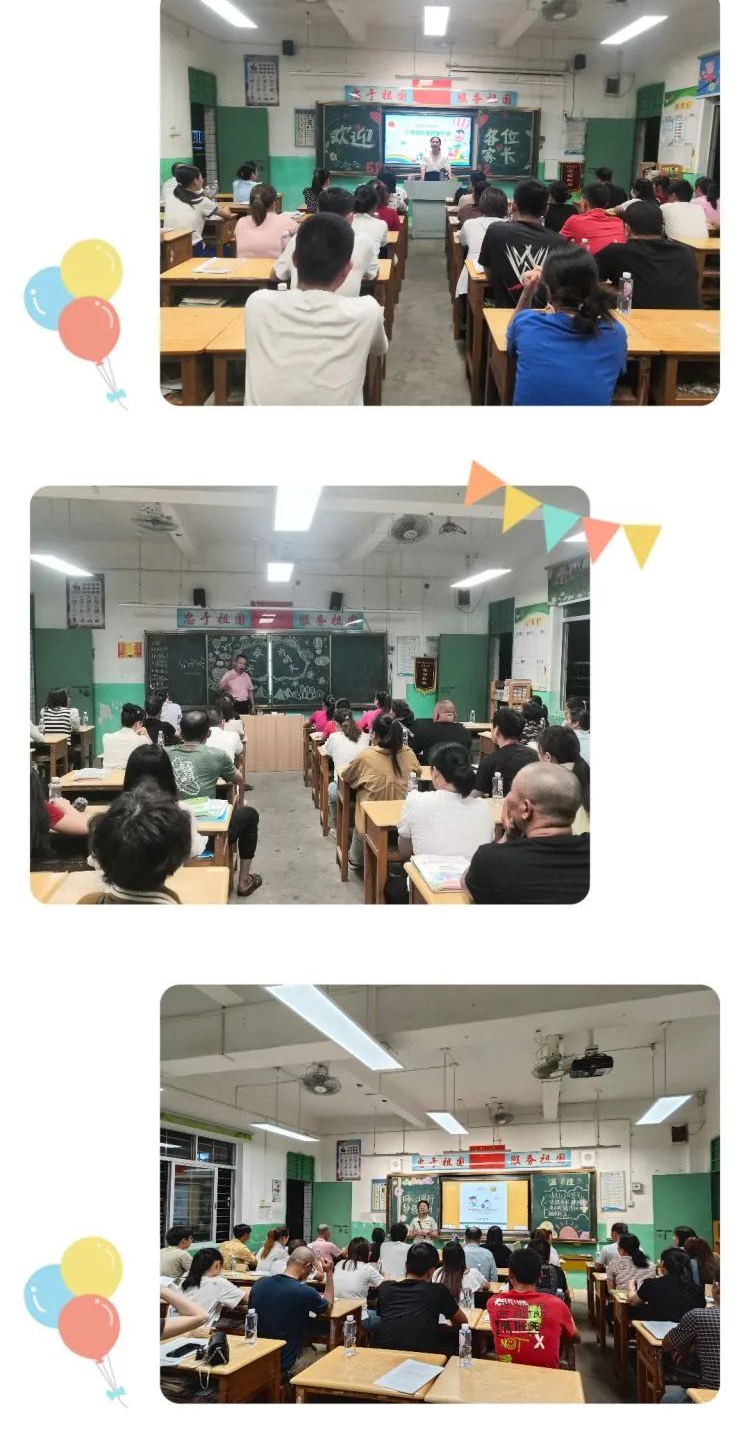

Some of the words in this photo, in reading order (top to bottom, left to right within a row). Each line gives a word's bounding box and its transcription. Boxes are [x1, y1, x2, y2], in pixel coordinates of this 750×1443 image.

[483, 127, 520, 145] 各位
[183, 611, 245, 624] 忠于祖国
